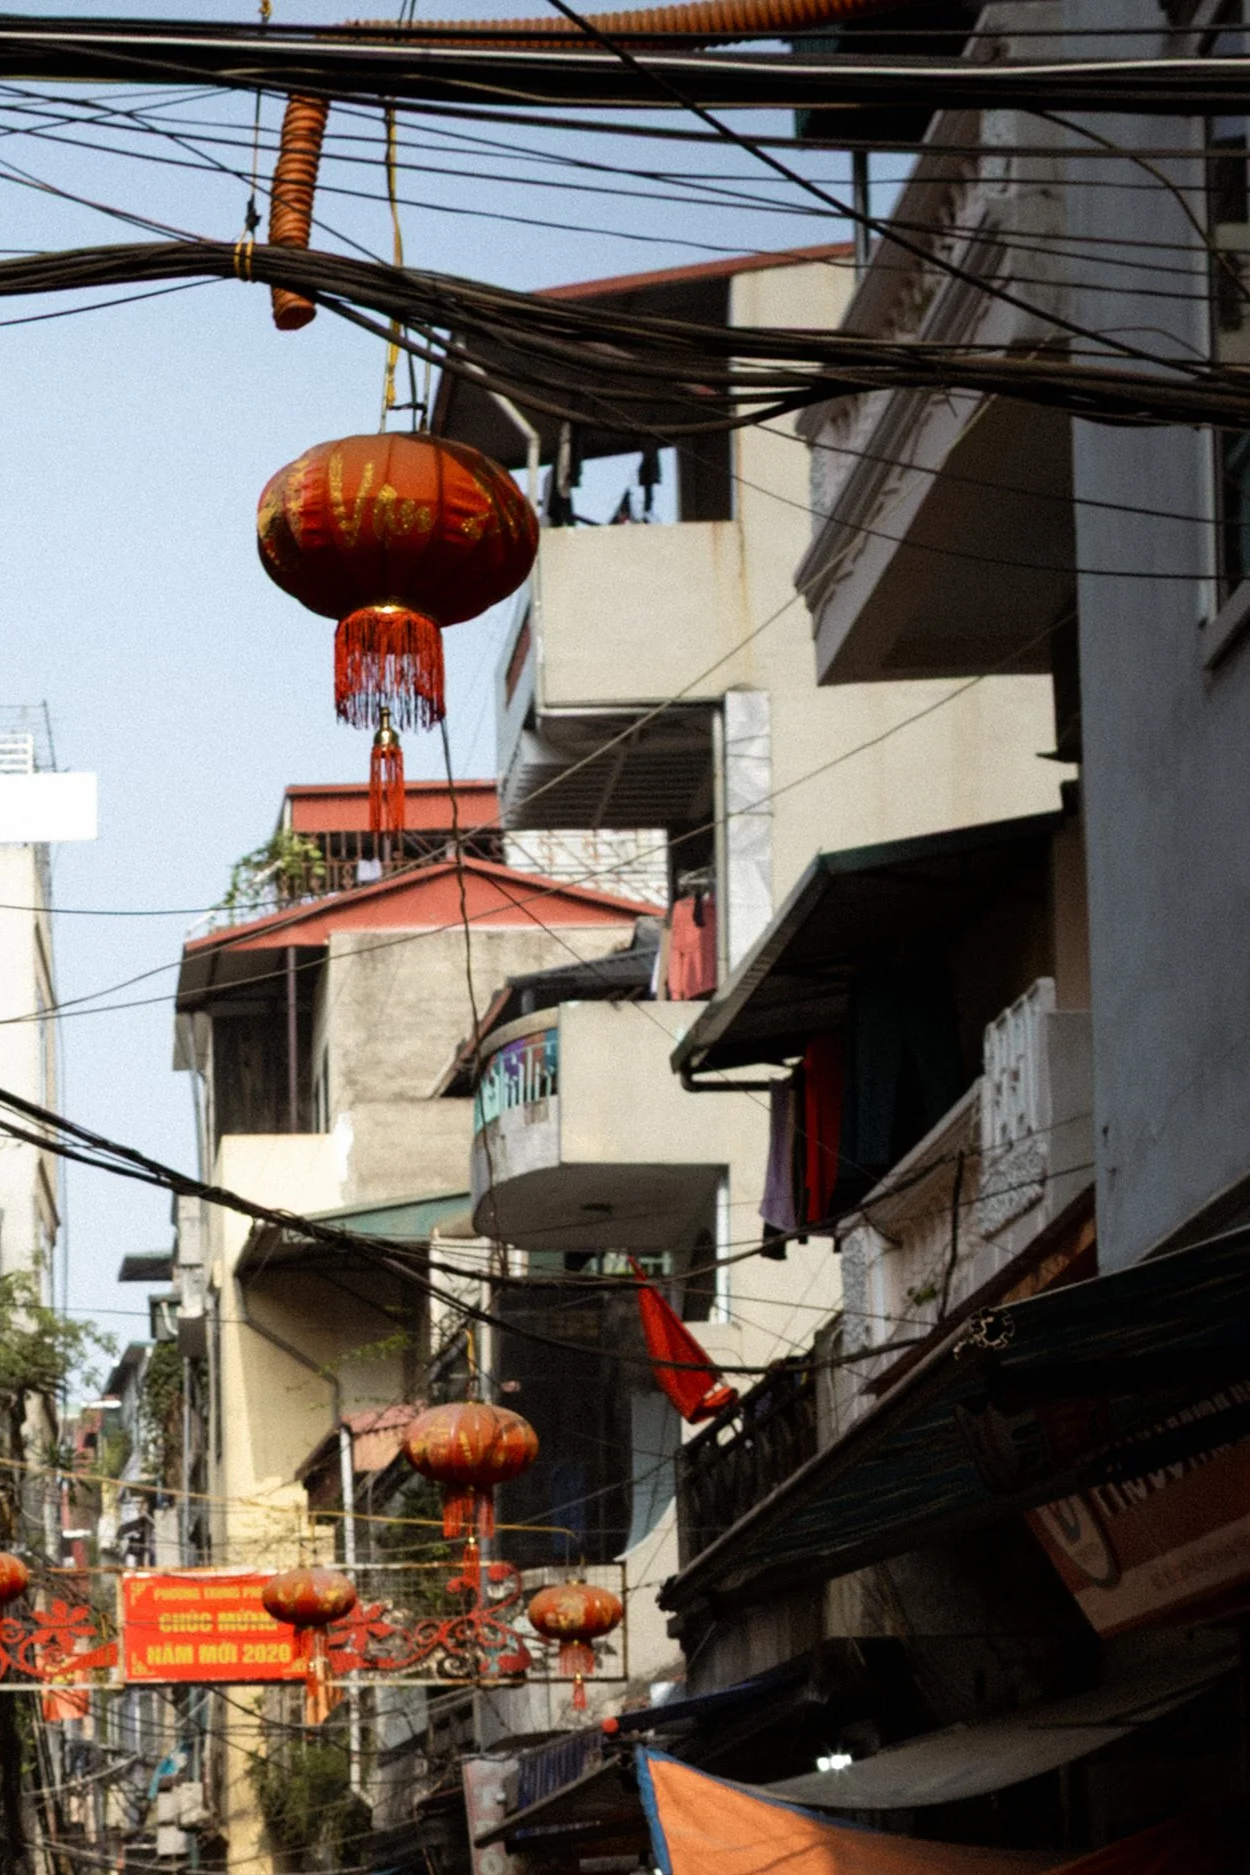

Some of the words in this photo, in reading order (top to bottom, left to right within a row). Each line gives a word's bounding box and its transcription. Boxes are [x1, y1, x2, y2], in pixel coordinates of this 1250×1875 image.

[146, 1641, 194, 1666] NĂM
[200, 1640, 238, 1664] MỚI
[242, 1643, 292, 1663] 2020
